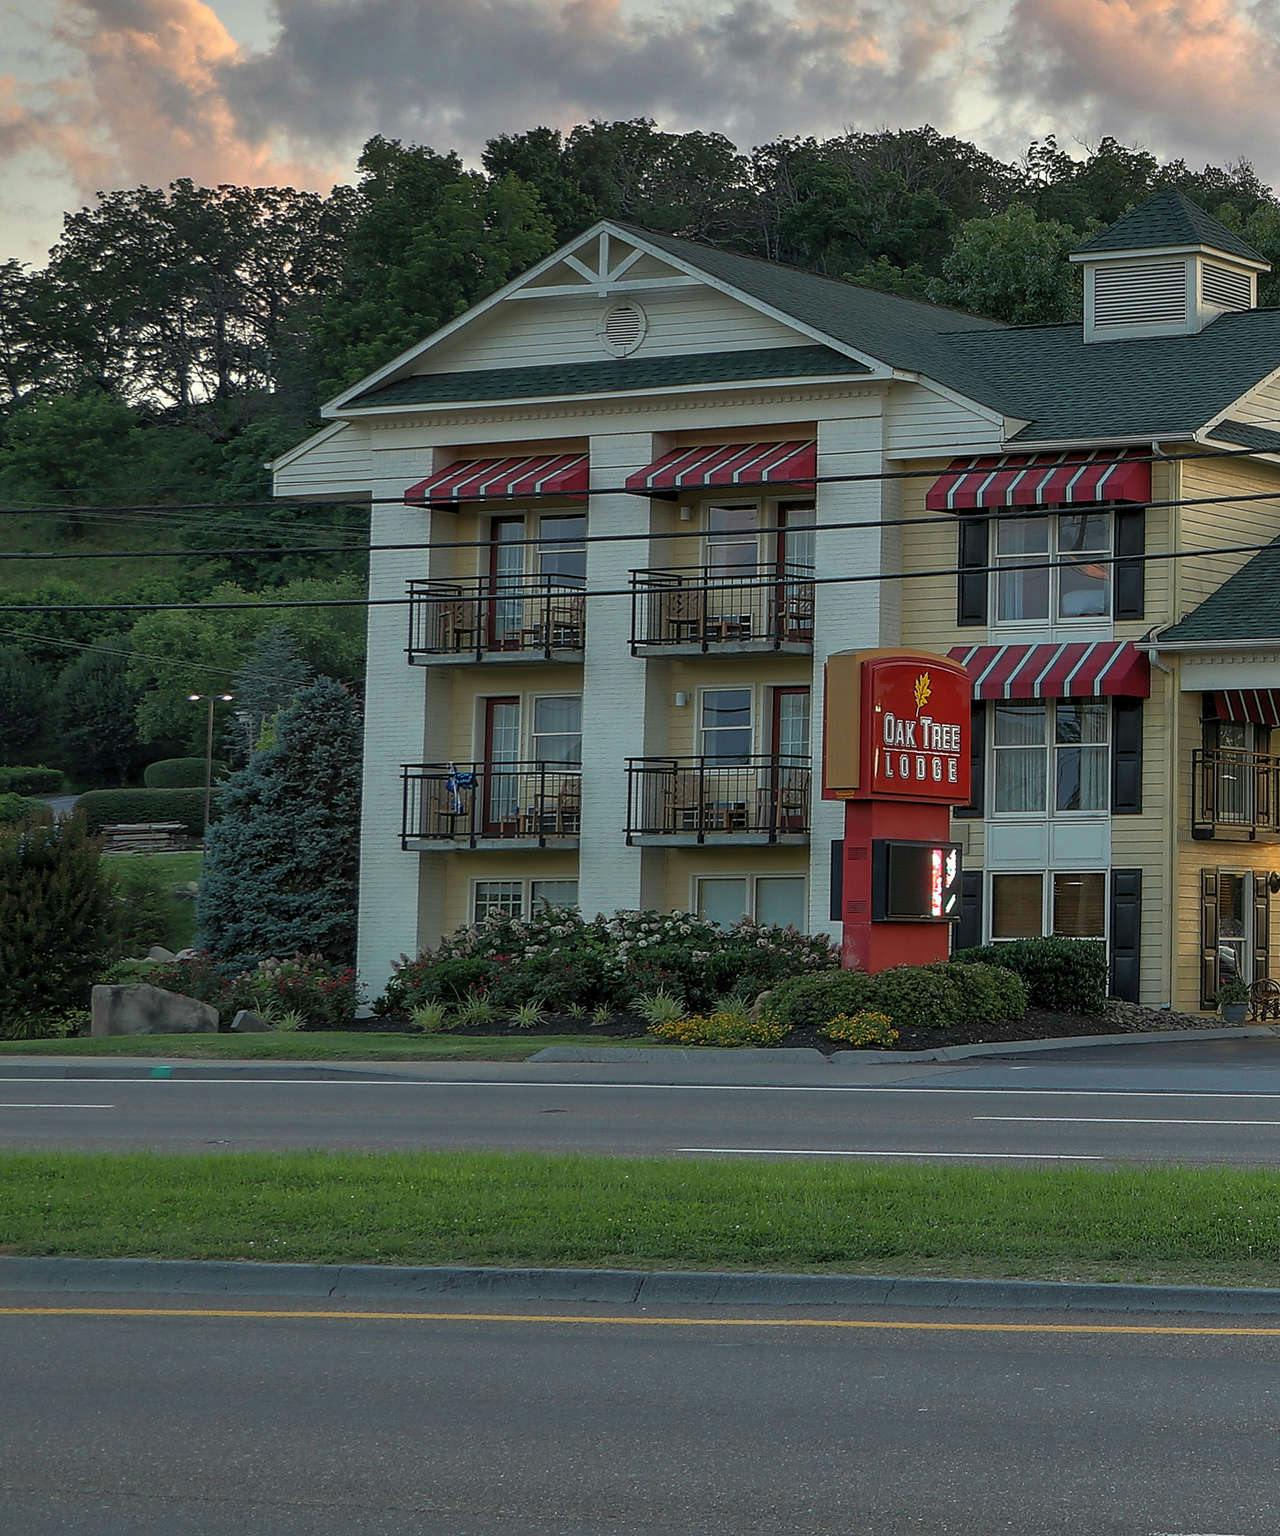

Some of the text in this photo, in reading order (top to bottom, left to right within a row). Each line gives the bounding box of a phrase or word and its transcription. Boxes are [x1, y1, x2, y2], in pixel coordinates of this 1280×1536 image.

[884, 712, 960, 752] OAK TREE
[885, 752, 958, 783] LODGE
